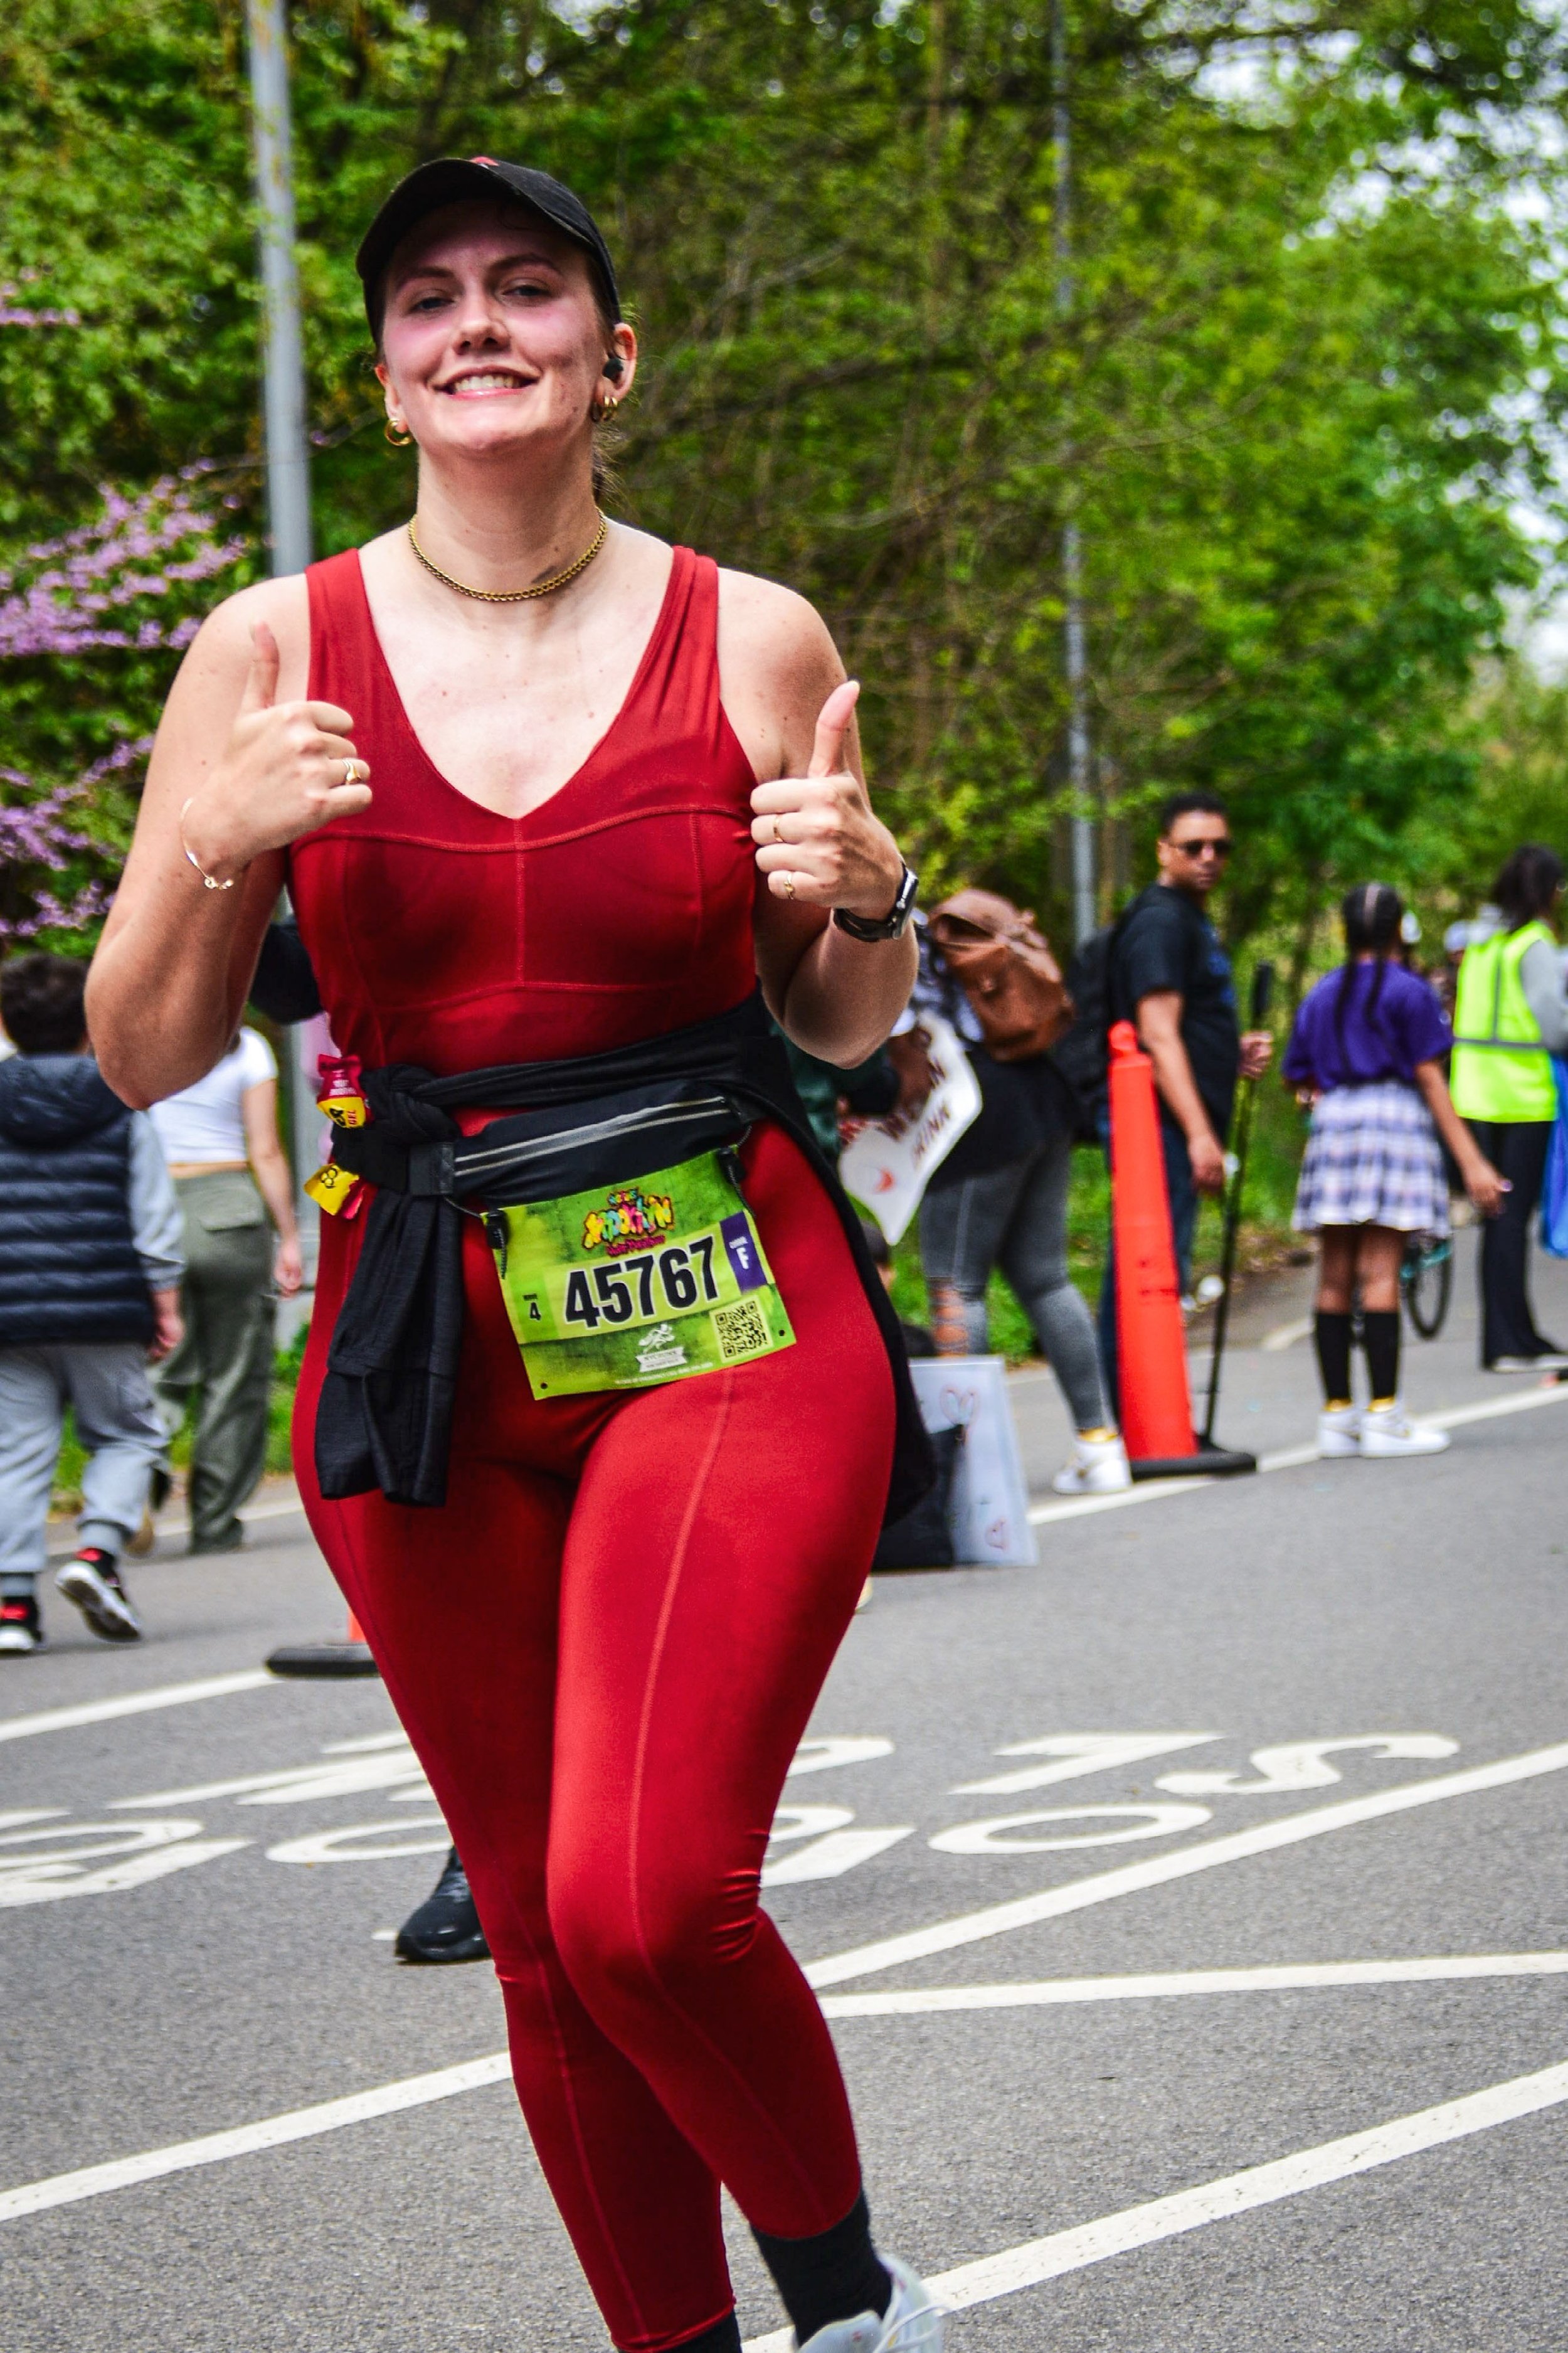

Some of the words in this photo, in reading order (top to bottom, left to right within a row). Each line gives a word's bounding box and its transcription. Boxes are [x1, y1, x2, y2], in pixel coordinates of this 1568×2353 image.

[735, 1247, 750, 1269] F
[566, 1237, 719, 1327] 45767
[529, 1302, 541, 1320] 4
